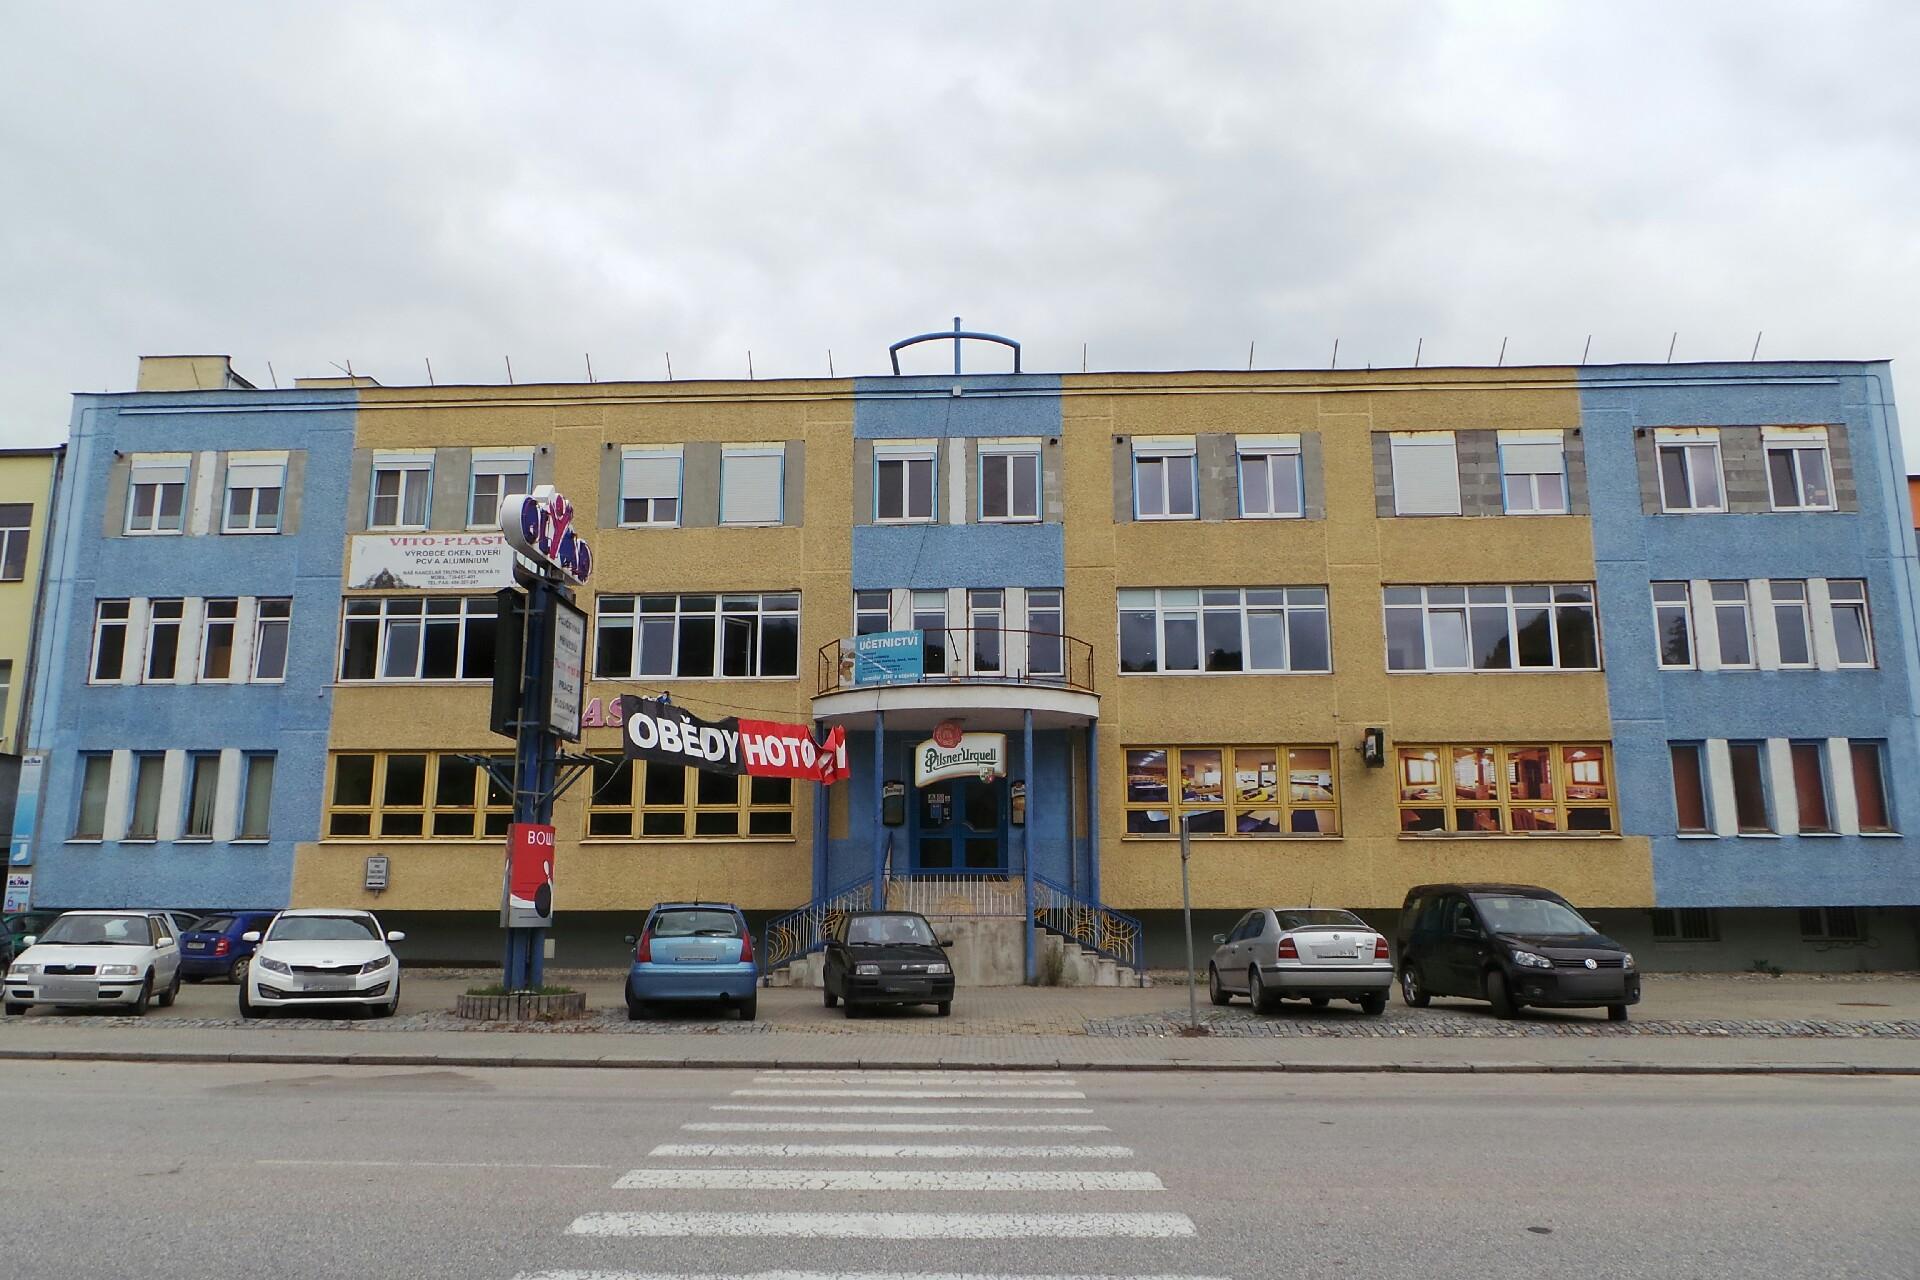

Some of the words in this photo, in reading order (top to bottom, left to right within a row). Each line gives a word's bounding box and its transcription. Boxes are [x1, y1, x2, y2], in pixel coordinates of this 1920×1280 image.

[389, 535, 504, 546] VITO-PLAST
[859, 634, 918, 650] ÚČETNICTVÍ
[628, 712, 740, 764] OBĚDY
[924, 747, 962, 773] Pilsner
[961, 747, 996, 767] Urquell
